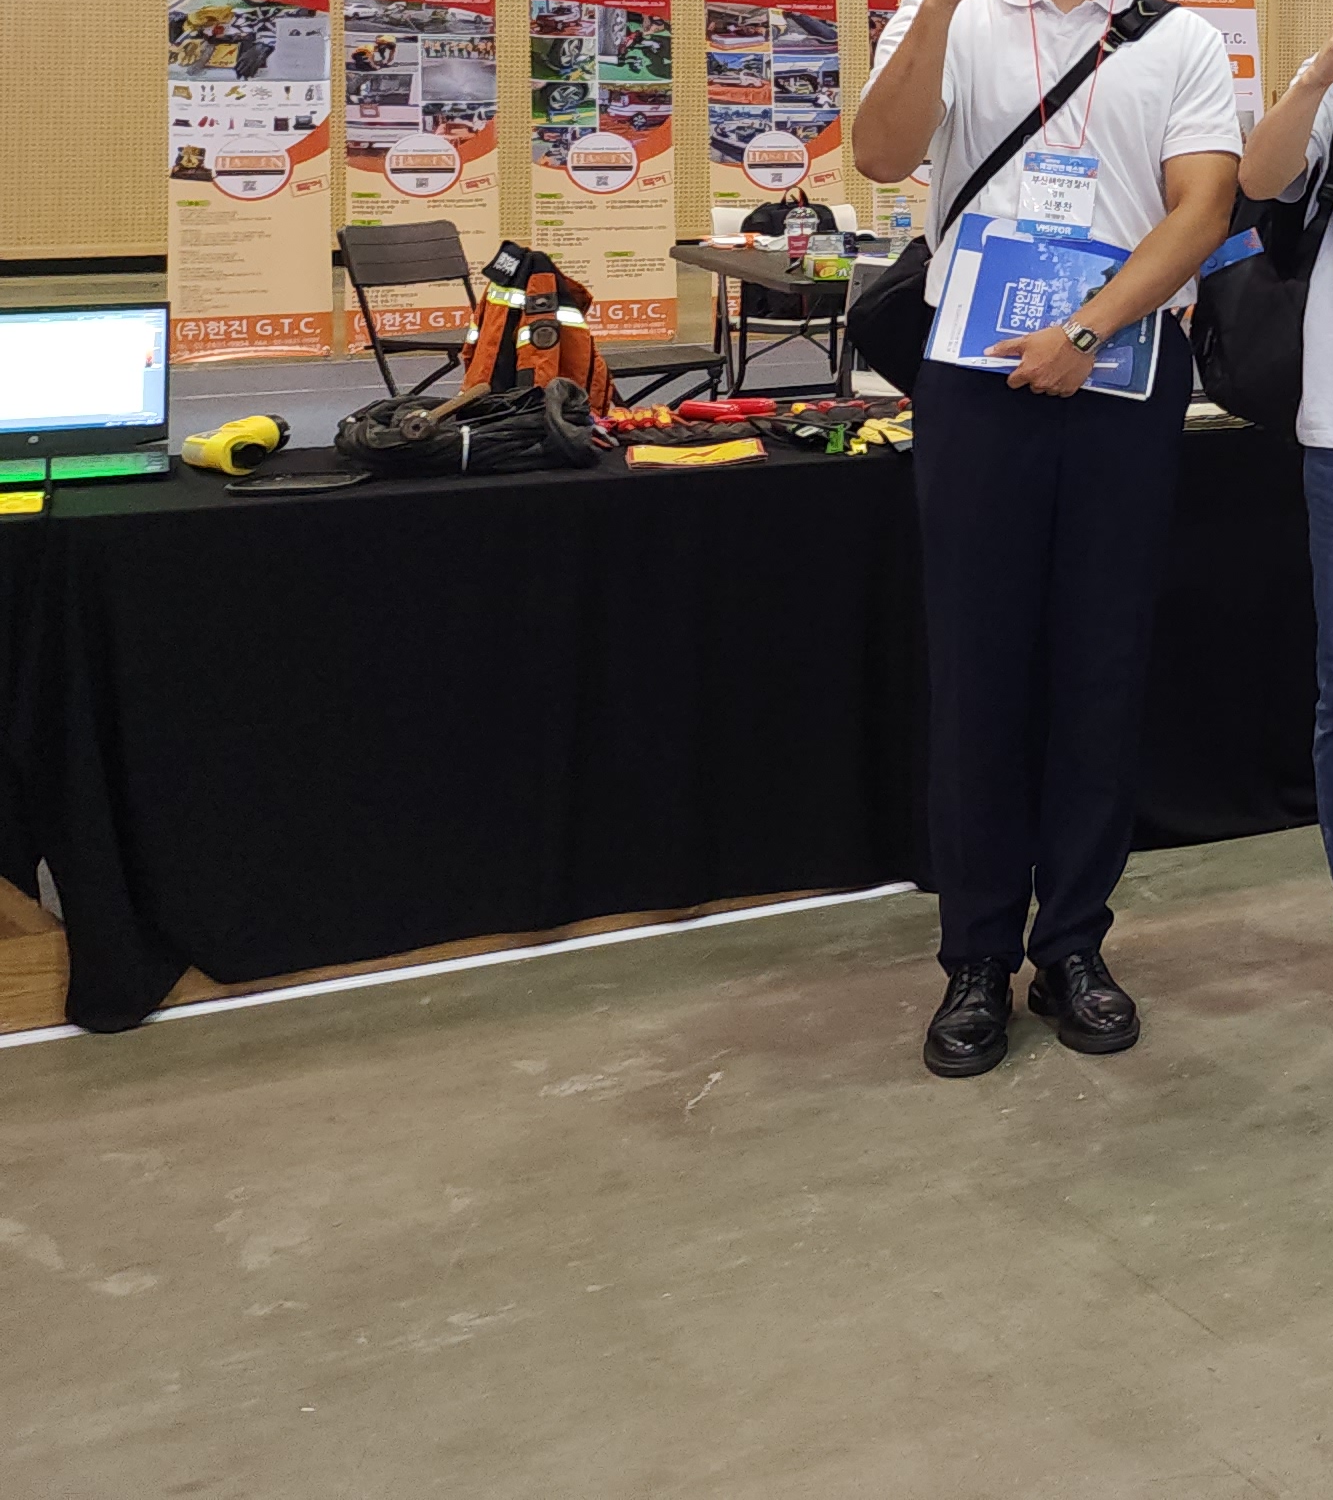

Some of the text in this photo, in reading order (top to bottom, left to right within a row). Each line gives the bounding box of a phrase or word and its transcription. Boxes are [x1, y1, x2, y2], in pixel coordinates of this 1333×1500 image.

[607, 303, 667, 320] G.T.C.
[175, 317, 321, 341] (주)한진 G.T.C.
